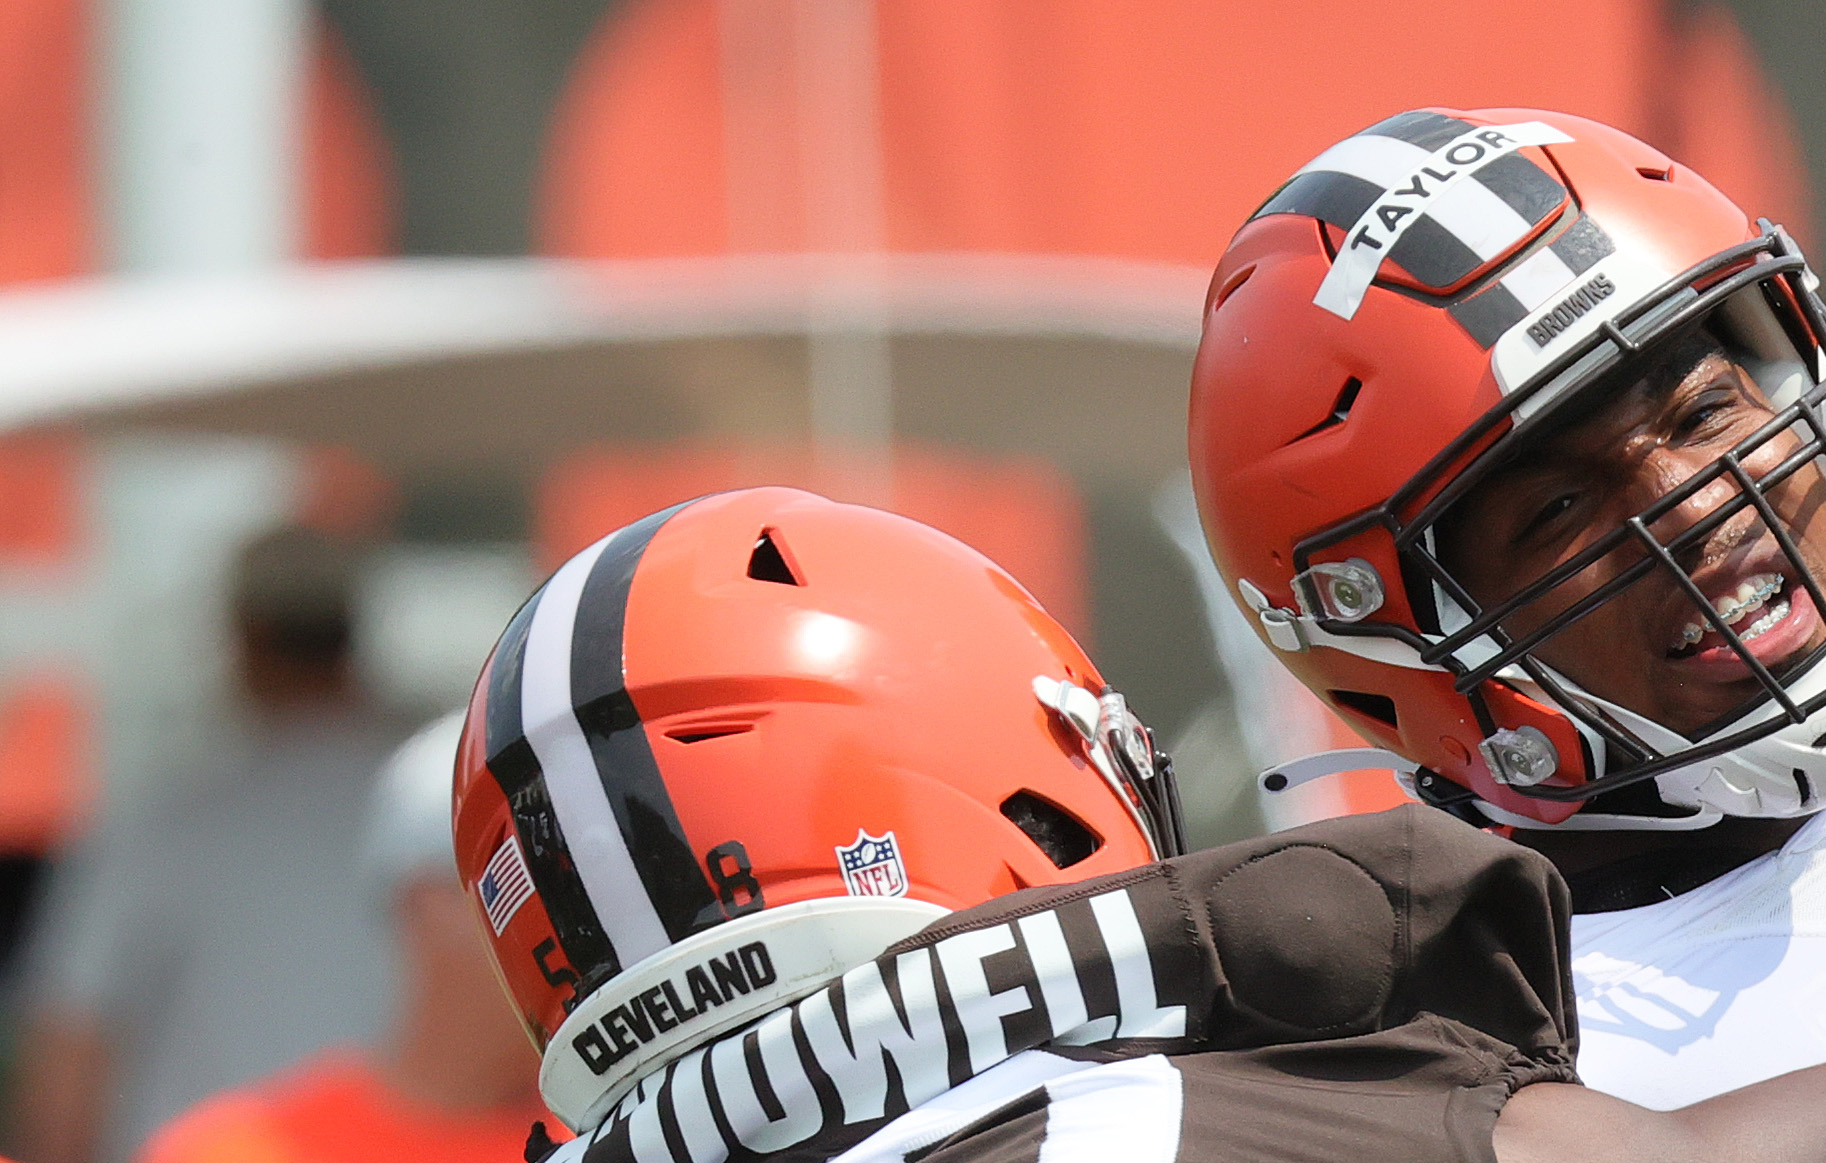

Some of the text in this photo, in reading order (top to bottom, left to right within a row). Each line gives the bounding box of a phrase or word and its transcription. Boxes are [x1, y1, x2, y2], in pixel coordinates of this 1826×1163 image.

[1351, 129, 1517, 256] TAYLOR
[1526, 273, 1616, 347] BROWNS
[706, 840, 766, 921] 8
[853, 863, 899, 897] NFL
[573, 940, 778, 1076] CLEVELAND
